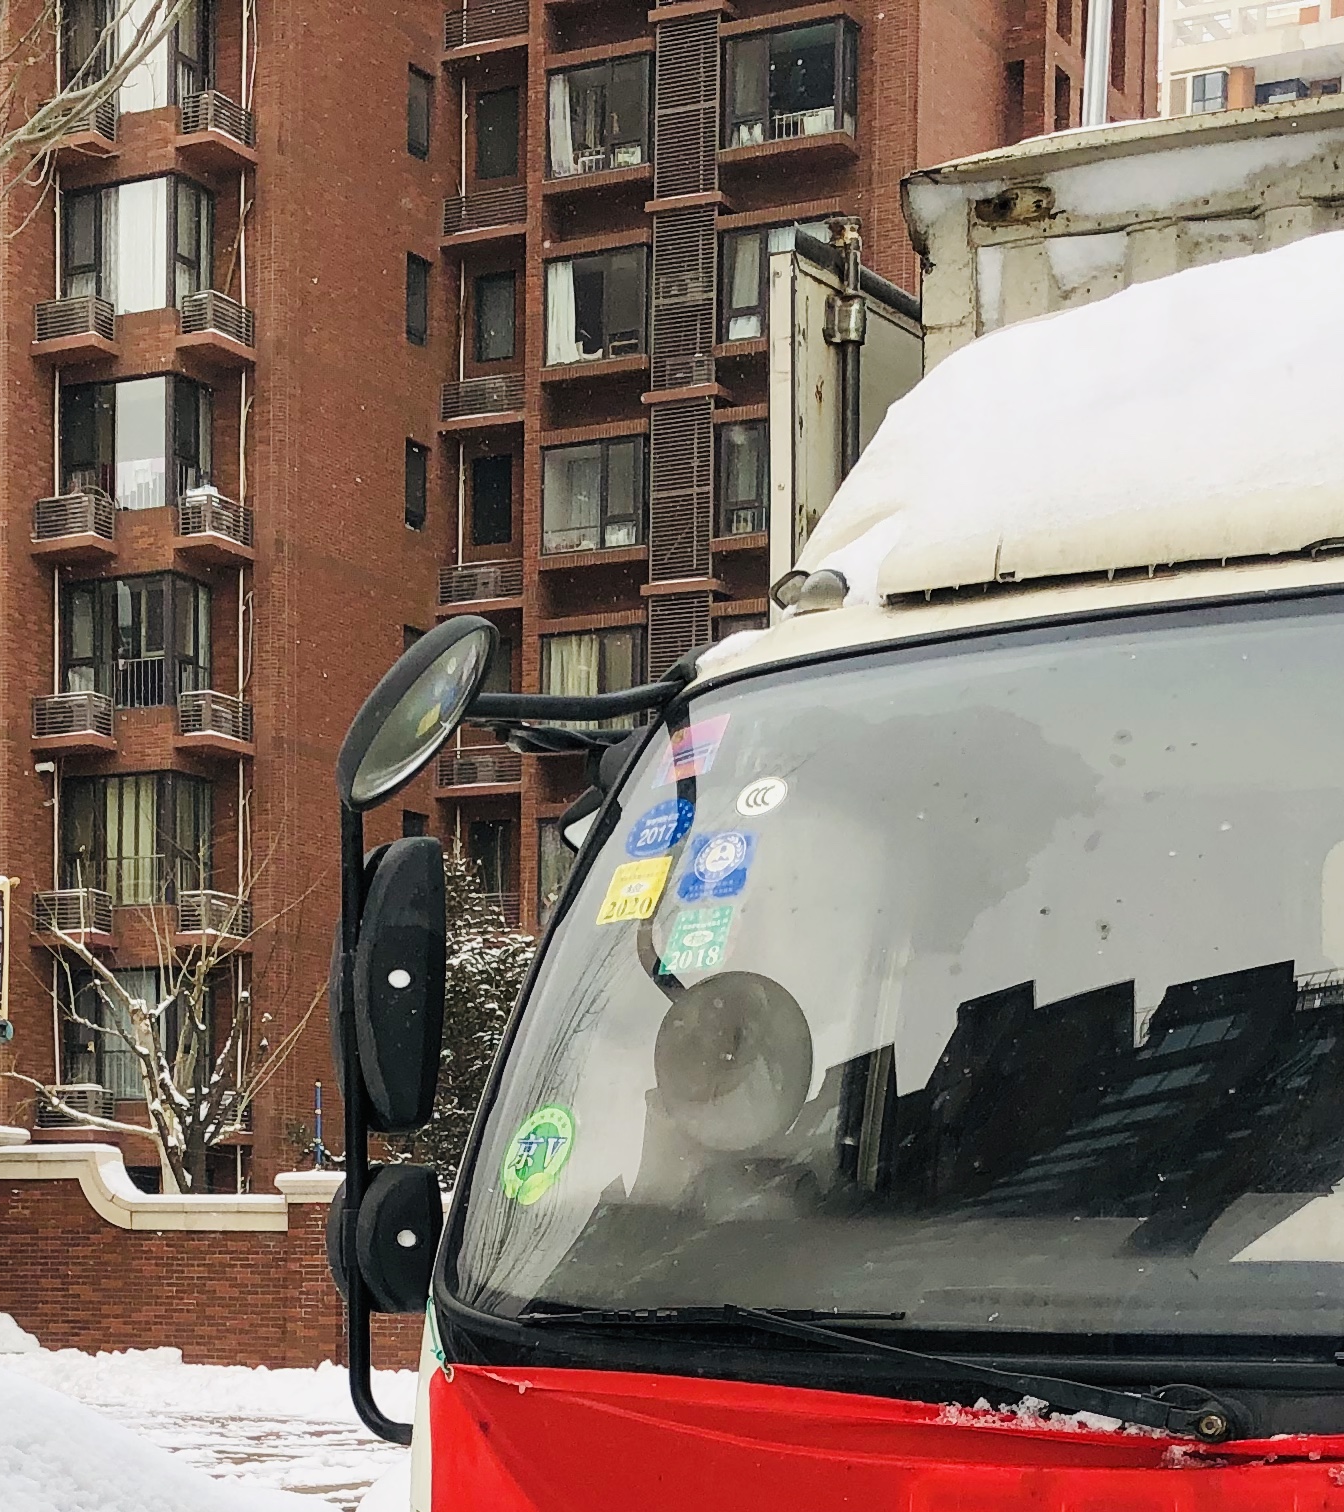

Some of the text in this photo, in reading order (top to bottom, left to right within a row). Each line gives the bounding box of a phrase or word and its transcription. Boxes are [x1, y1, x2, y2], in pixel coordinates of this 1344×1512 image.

[636, 821, 678, 848] 2017
[603, 897, 653, 920] 2020
[664, 945, 720, 971] 2018
[508, 1133, 569, 1170] 京V
